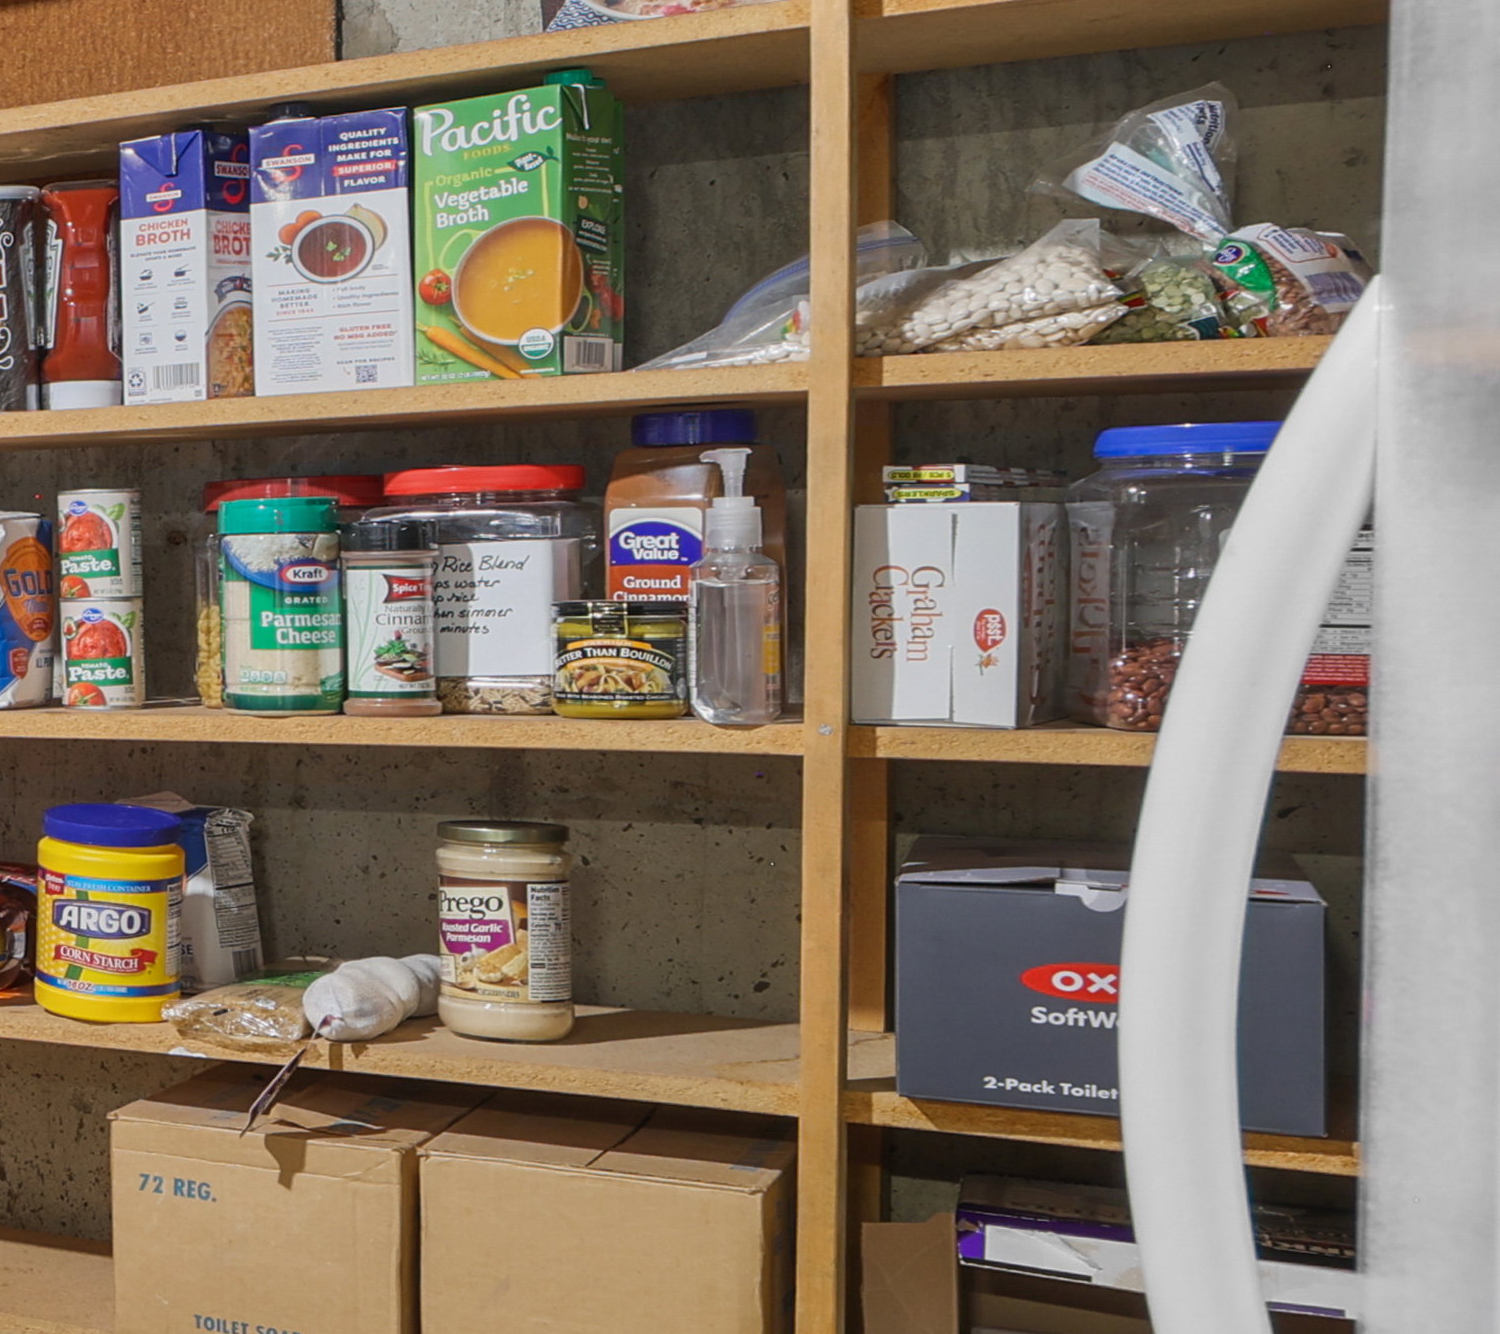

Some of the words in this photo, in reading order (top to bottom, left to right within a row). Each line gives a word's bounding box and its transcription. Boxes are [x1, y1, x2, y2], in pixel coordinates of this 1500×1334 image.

[421, 93, 563, 156] Pacific
[340, 128, 386, 140] QUALITY
[329, 137, 399, 152] INGREDIENTS
[463, 143, 513, 160] FOODS
[265, 155, 312, 167] SWANSON
[336, 151, 367, 162] MAKE
[370, 149, 392, 158] FOR
[339, 161, 393, 174] SUPERIOR
[344, 176, 386, 187] FLAVOR
[435, 168, 492, 187] Organic
[435, 178, 529, 211] Vegetable
[436, 205, 489, 228] Broth
[139, 218, 188, 232] CHICKEN
[135, 228, 190, 246] BROTH
[619, 532, 679, 550] Great
[631, 548, 680, 561] Value
[442, 555, 473, 572] Rice
[479, 554, 530, 572] Blend
[293, 568, 322, 579] Kraft
[455, 578, 501, 589] water
[623, 576, 681, 589] Ground
[458, 608, 514, 619] simmer
[907, 566, 945, 662] Graham
[276, 628, 336, 644] Cheese
[439, 624, 490, 635] minutes
[586, 647, 618, 659] THAN
[620, 647, 673, 669] BOUILLON
[438, 889, 503, 921] Prego
[60, 906, 144, 934] ARGO
[470, 922, 503, 934] Garlic
[446, 933, 491, 943] Parmesan
[60, 945, 92, 967] CORN
[94, 953, 139, 971] STARCH
[983, 1076, 1055, 1096] 2-Pack
[1060, 1081, 1118, 1100] Toilet
[138, 1173, 164, 1195] 72
[173, 1178, 217, 1203] REG.
